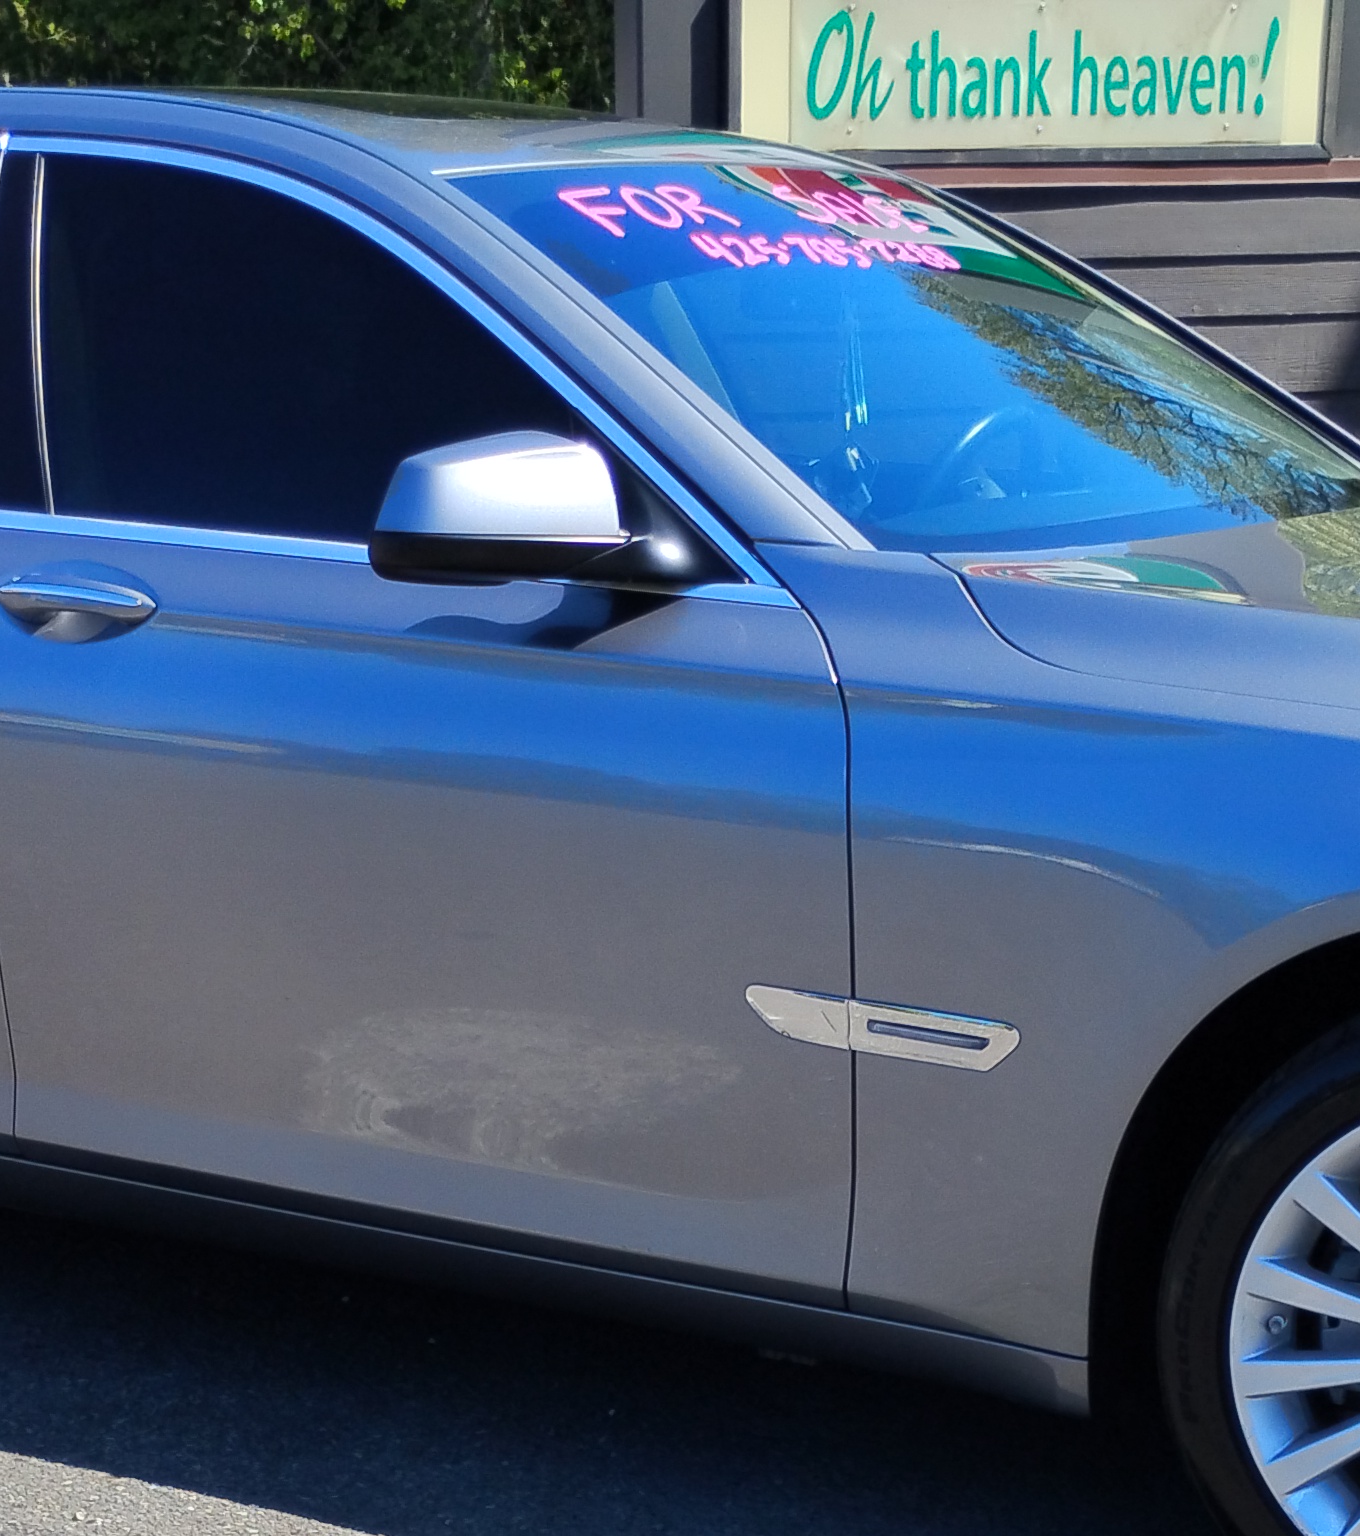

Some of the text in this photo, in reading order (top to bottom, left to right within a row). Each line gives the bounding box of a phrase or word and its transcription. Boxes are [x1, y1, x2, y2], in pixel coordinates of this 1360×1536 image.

[806, 10, 895, 121] Oh
[905, 29, 1052, 119] thank
[557, 184, 929, 238] FOR SALE
